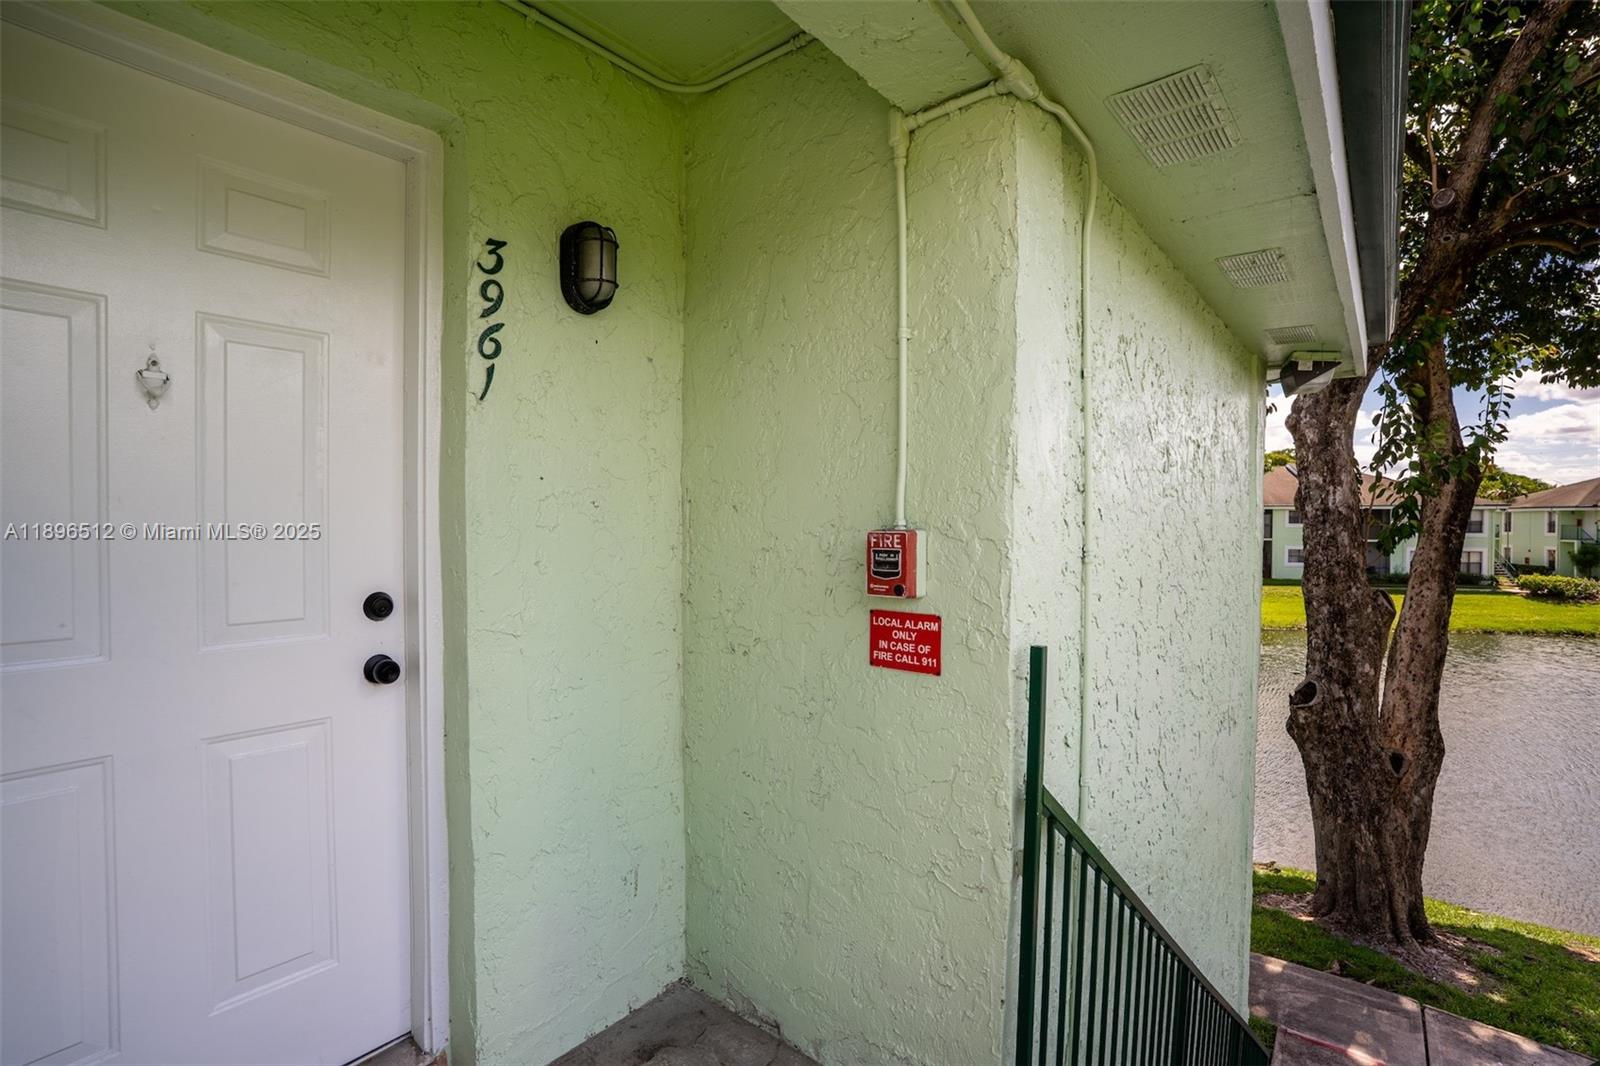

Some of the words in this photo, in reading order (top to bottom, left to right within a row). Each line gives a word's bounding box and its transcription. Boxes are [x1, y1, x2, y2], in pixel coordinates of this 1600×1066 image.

[476, 237, 508, 401] 3961
[870, 534, 902, 548] FIRE
[873, 616, 903, 628] LOCAL
[904, 620, 939, 631] ALARM
[892, 630, 917, 641] ONLY
[879, 640, 888, 649] IN
[890, 641, 915, 653] CASE
[918, 645, 931, 654] OF
[873, 650, 893, 661] FIRE
[895, 654, 920, 665] CALL
[922, 657, 937, 668] 911
